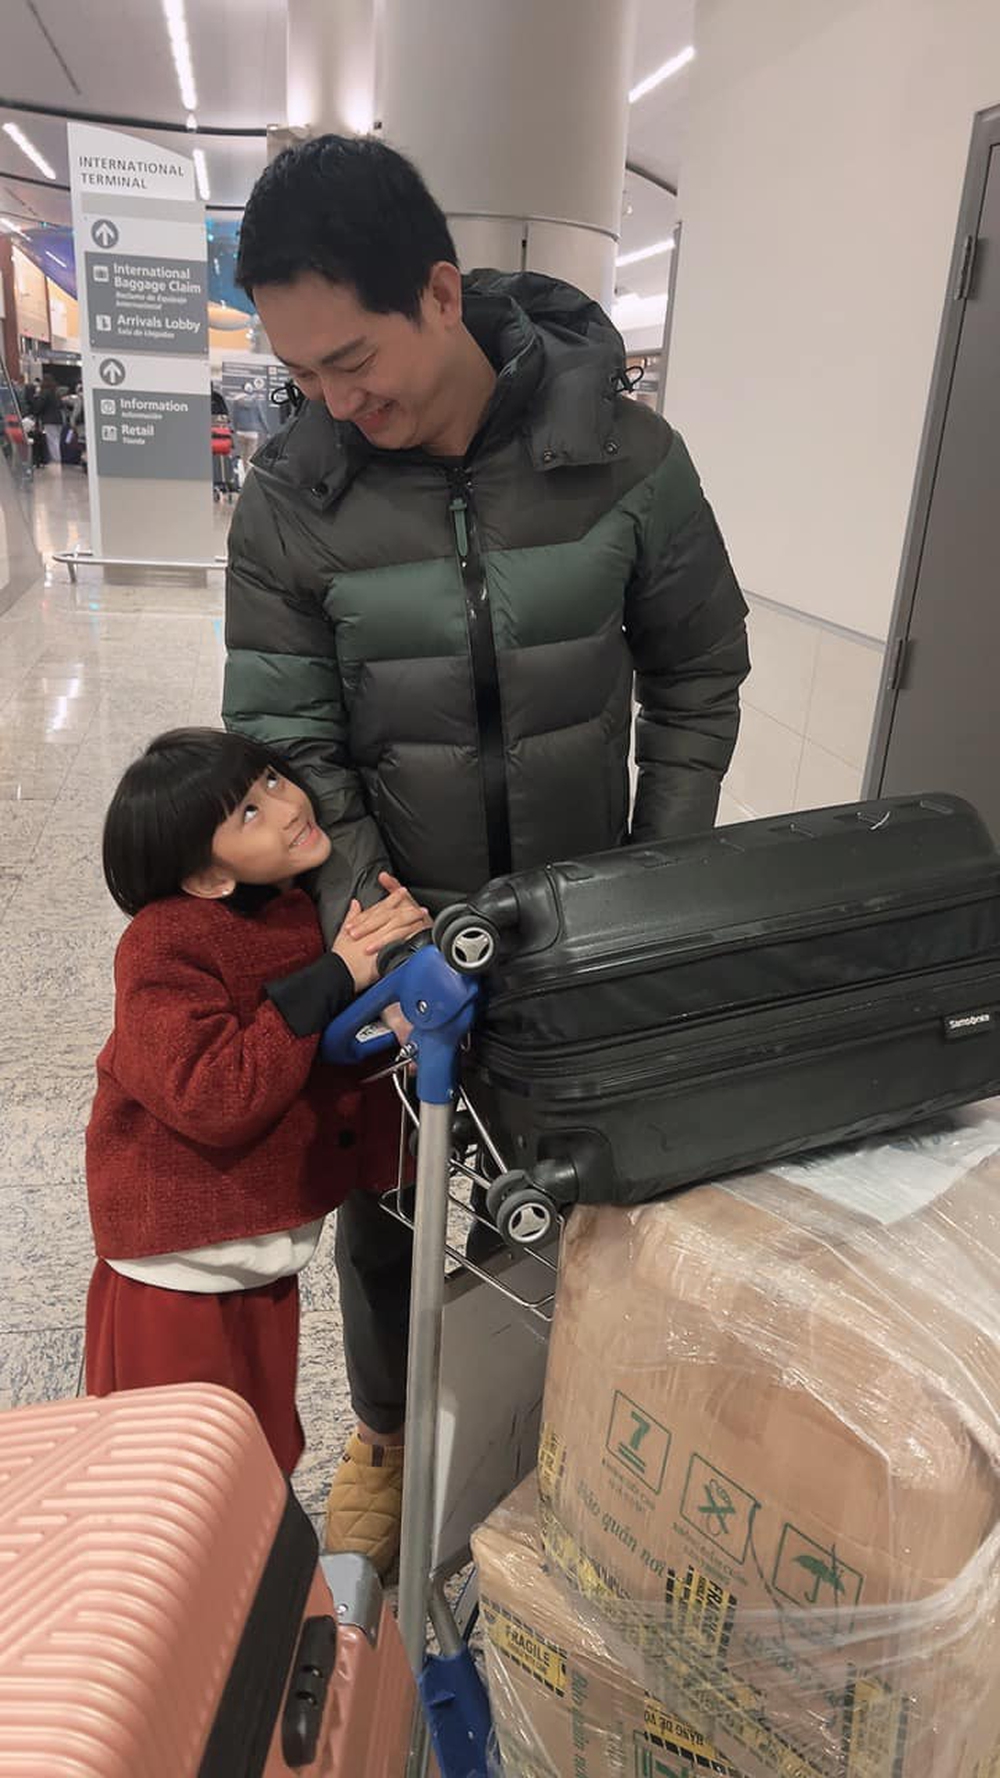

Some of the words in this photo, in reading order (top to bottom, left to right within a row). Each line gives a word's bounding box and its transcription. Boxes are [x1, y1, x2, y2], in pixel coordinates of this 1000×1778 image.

[79, 156, 184, 177] INTERNATIONAL
[81, 173, 148, 189] TERMINAL
[113, 262, 190, 279] International
[114, 277, 166, 293] Baggage
[169, 279, 201, 293] Claim
[117, 314, 162, 328] Arrivals
[165, 317, 201, 333] Lobby
[120, 398, 189, 412] Information
[121, 424, 155, 436] Retail
